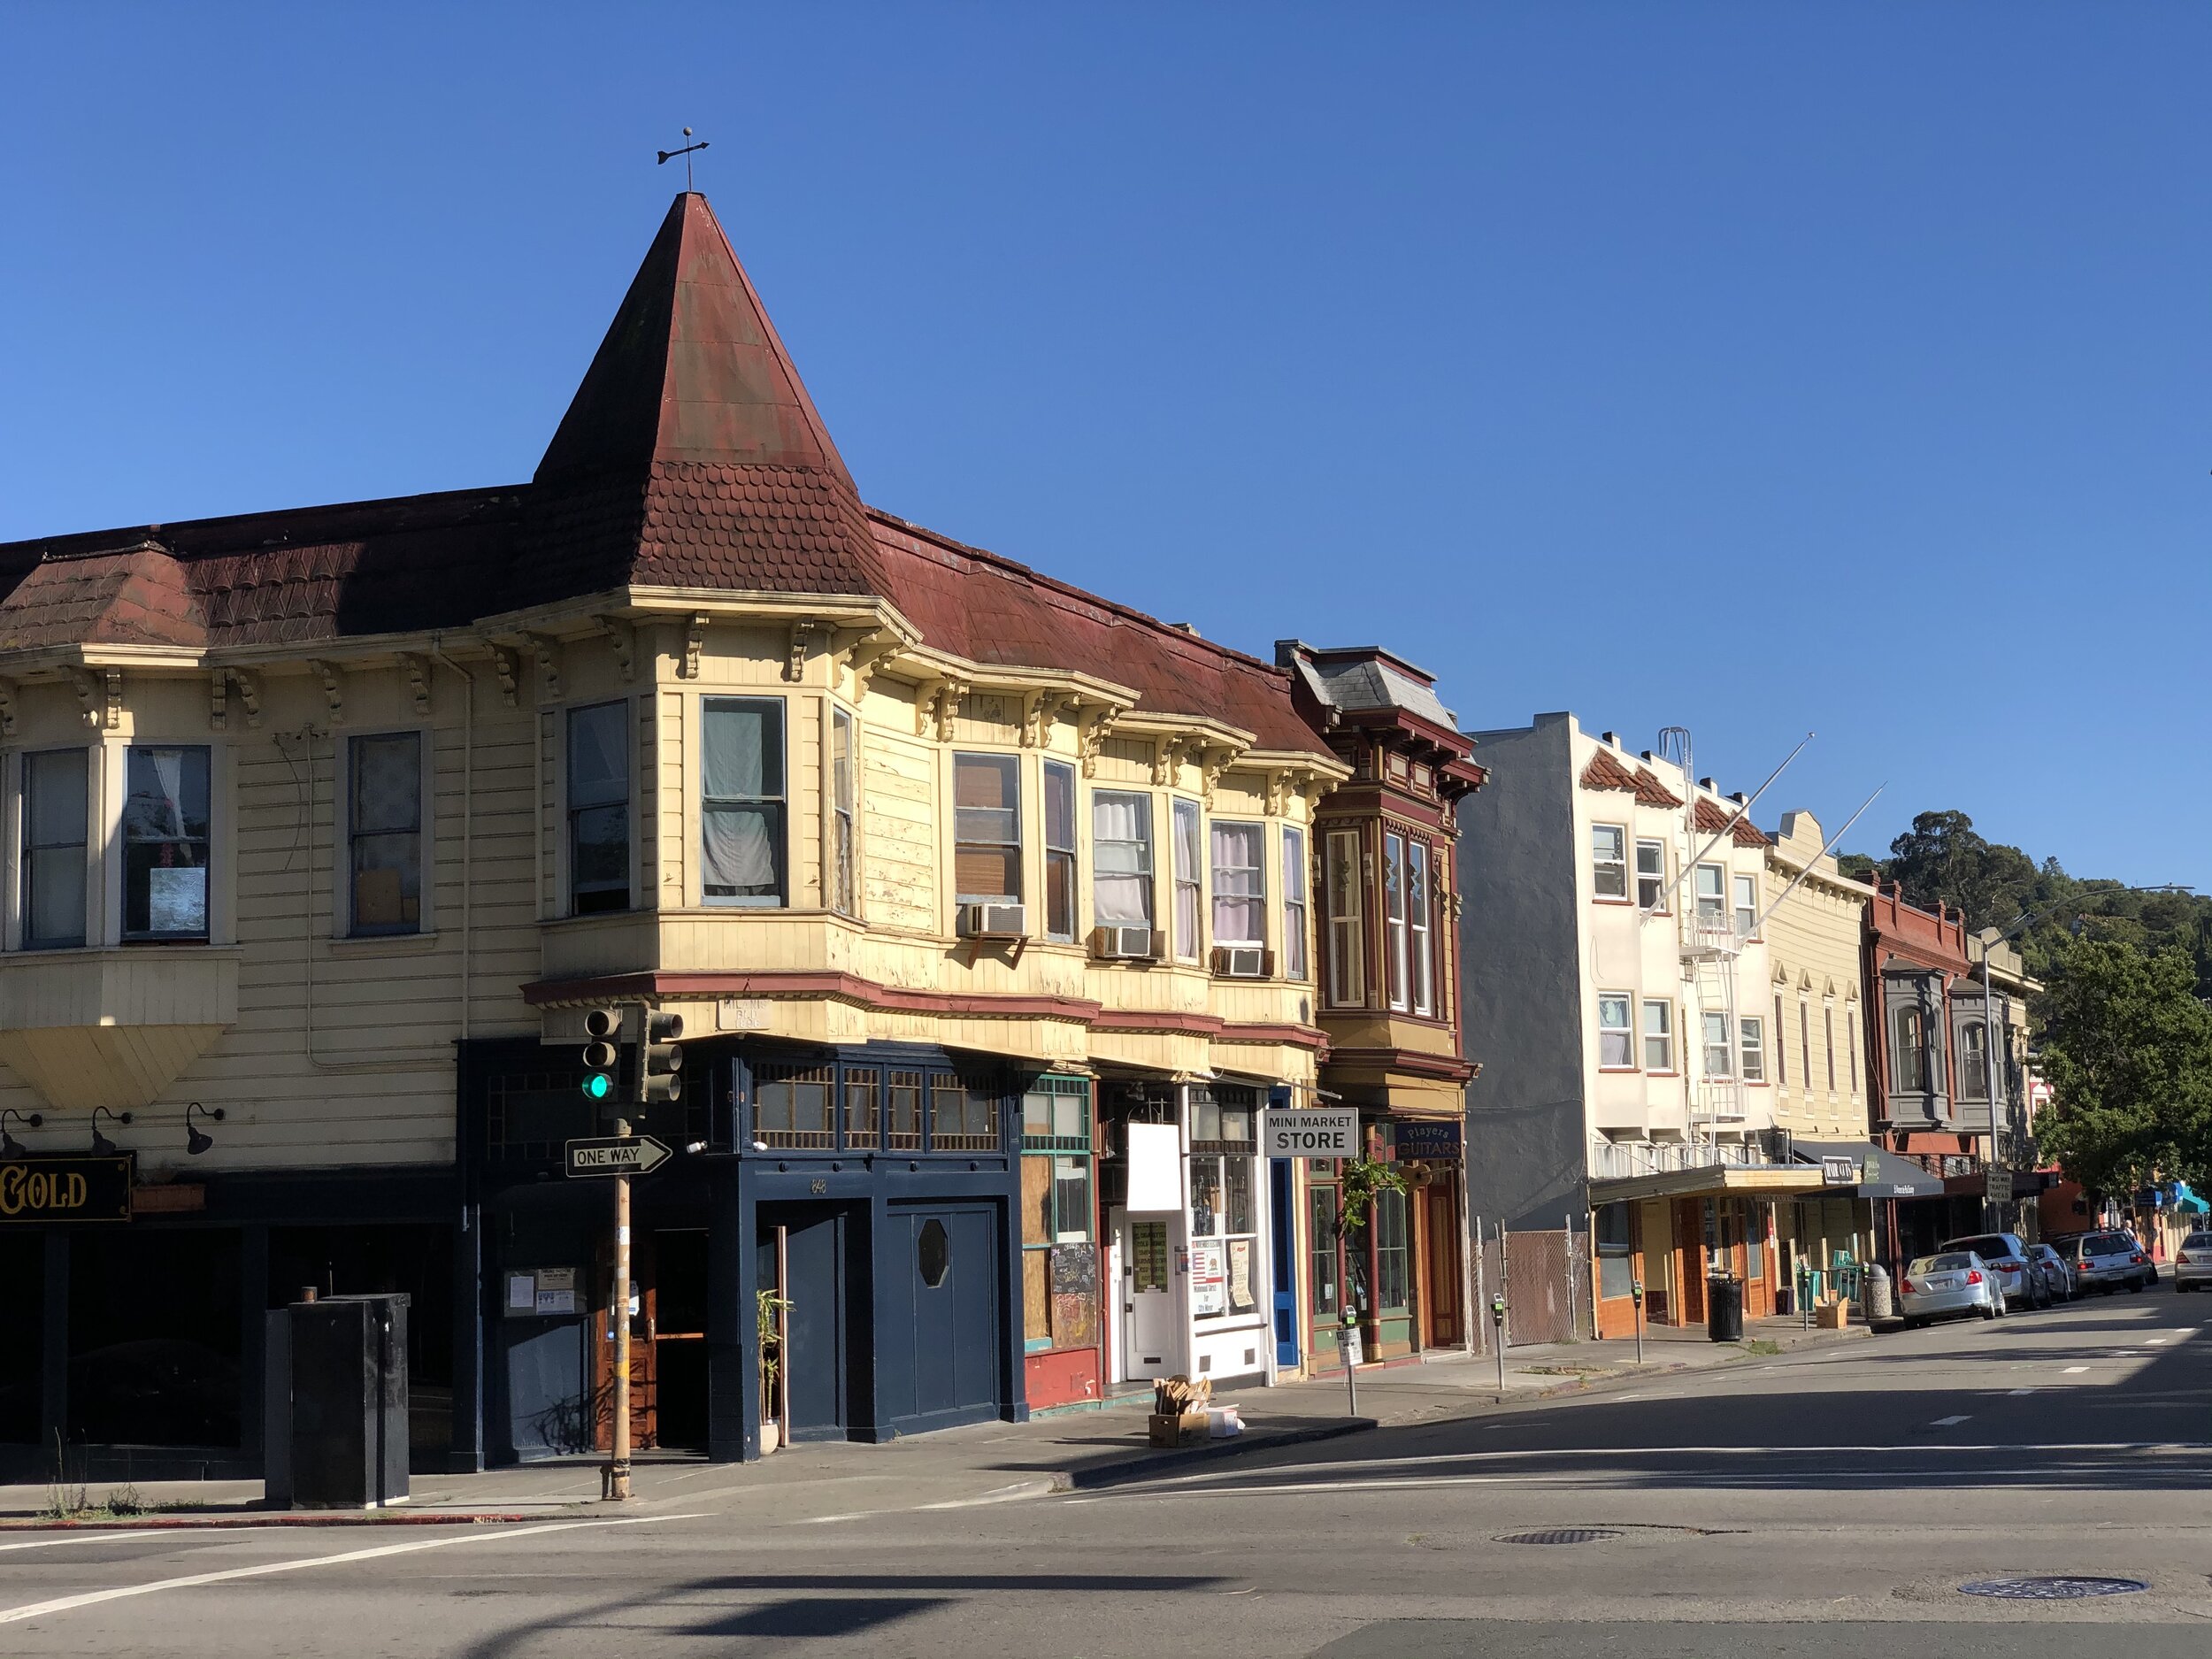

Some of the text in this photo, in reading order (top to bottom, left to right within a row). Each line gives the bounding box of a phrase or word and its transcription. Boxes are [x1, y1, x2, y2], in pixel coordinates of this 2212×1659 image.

[1269, 1116, 1352, 1128] MINI MARKET
[1276, 1132, 1346, 1149] STORE
[1407, 1125, 1449, 1140] Players
[577, 1148, 640, 1164] ONE WAY
[1398, 1141, 1460, 1156] GUITARS
[1825, 1162, 1839, 1178] HAIR
[1839, 1163, 1852, 1178] CUTS
[0, 1165, 87, 1215] GOLD
